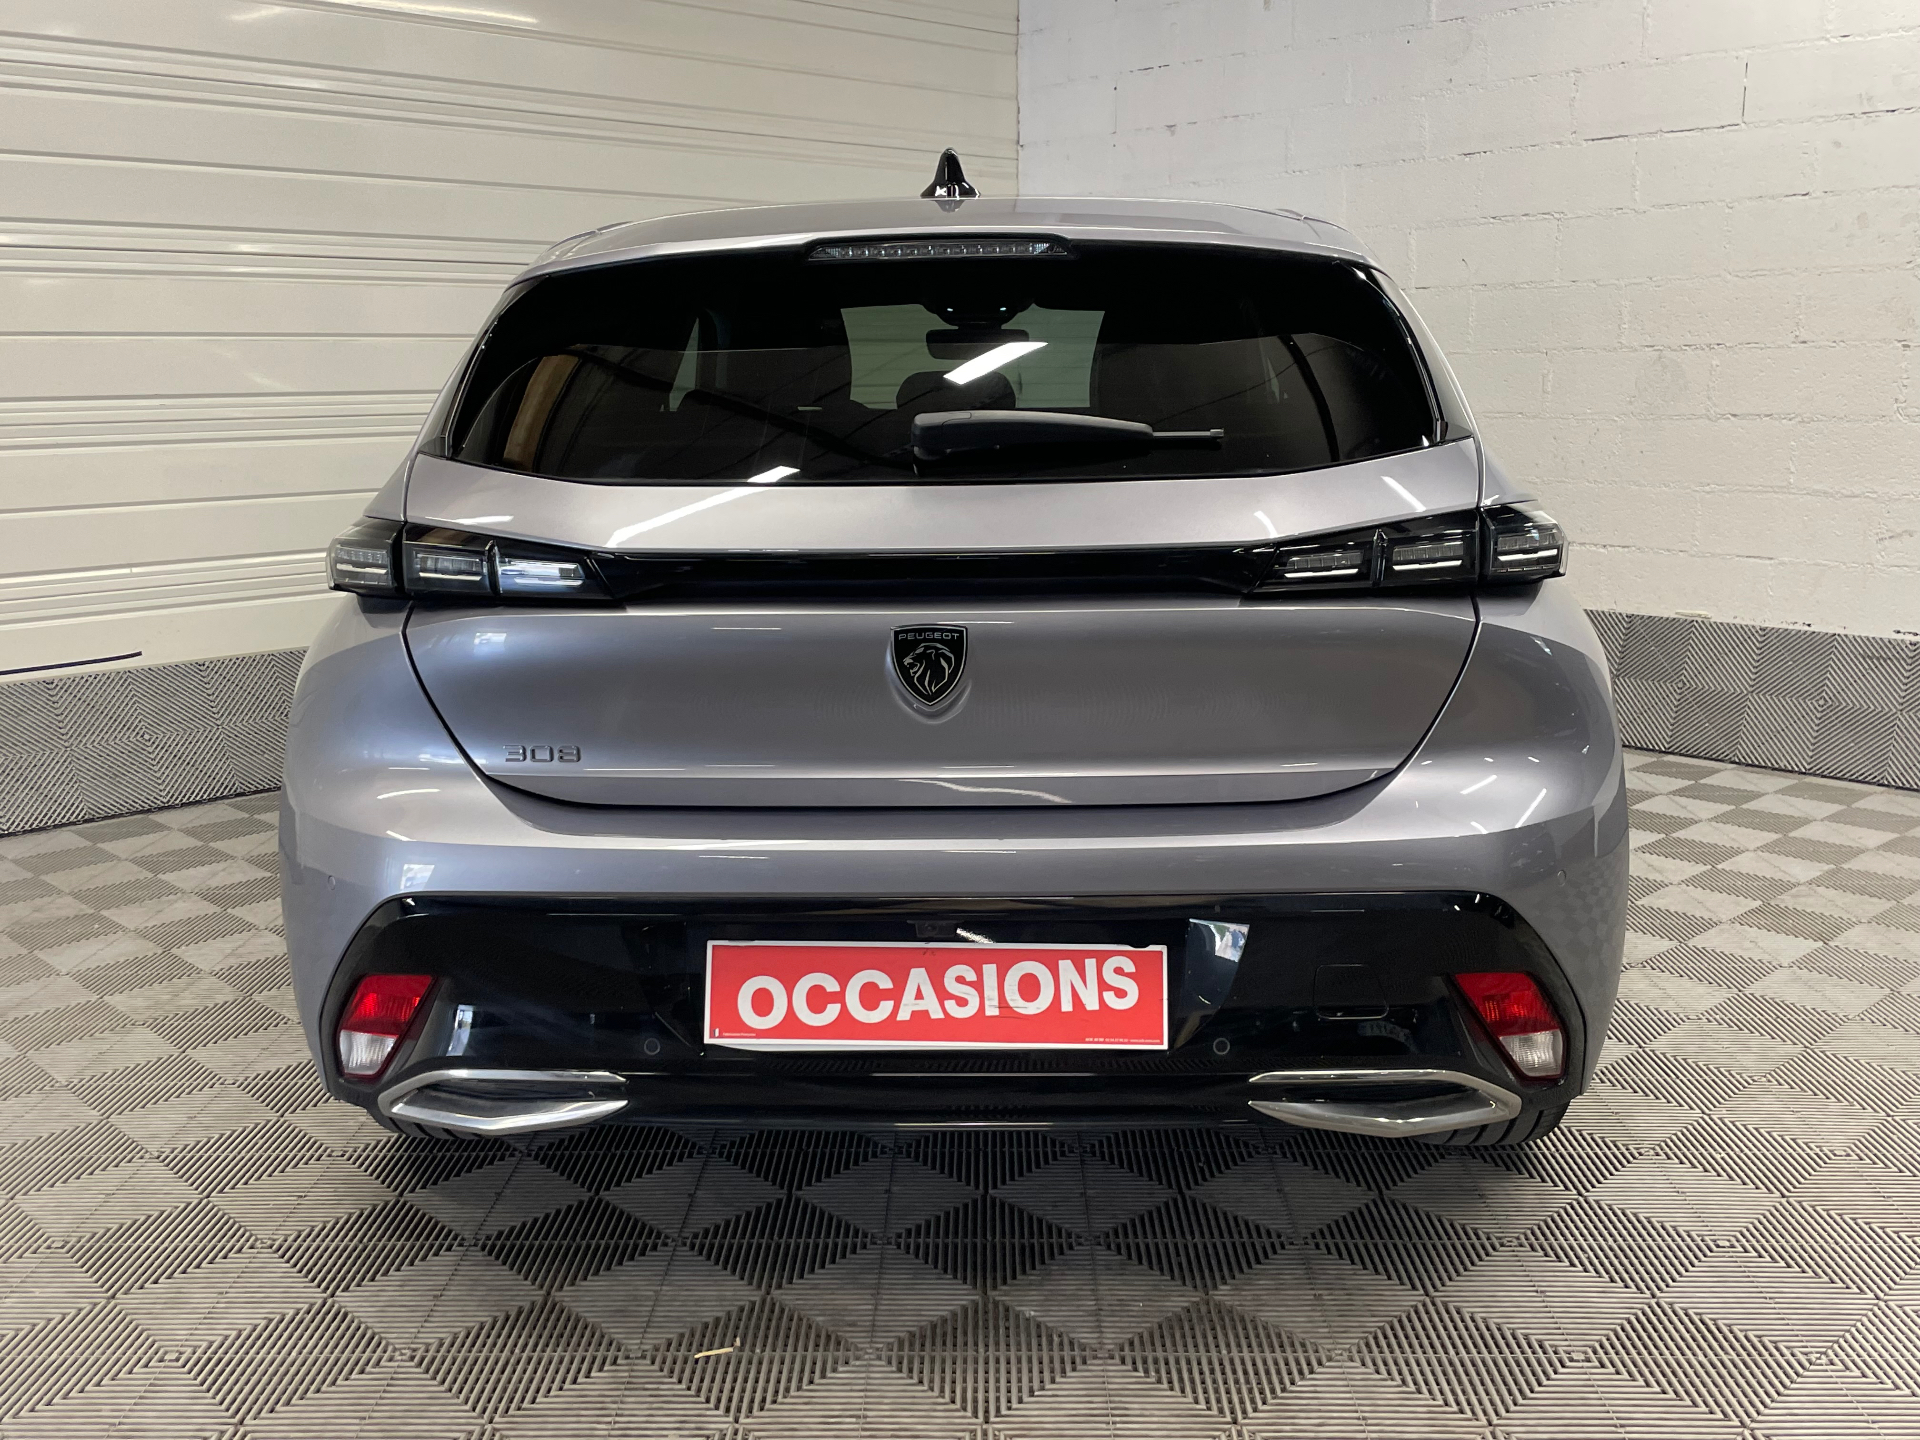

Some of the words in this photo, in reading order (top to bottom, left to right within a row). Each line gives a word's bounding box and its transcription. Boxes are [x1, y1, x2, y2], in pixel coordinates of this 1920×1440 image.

[898, 632, 960, 640] PEUGEOT
[503, 744, 582, 763] 308
[737, 955, 1139, 1030] OCCASIONS
